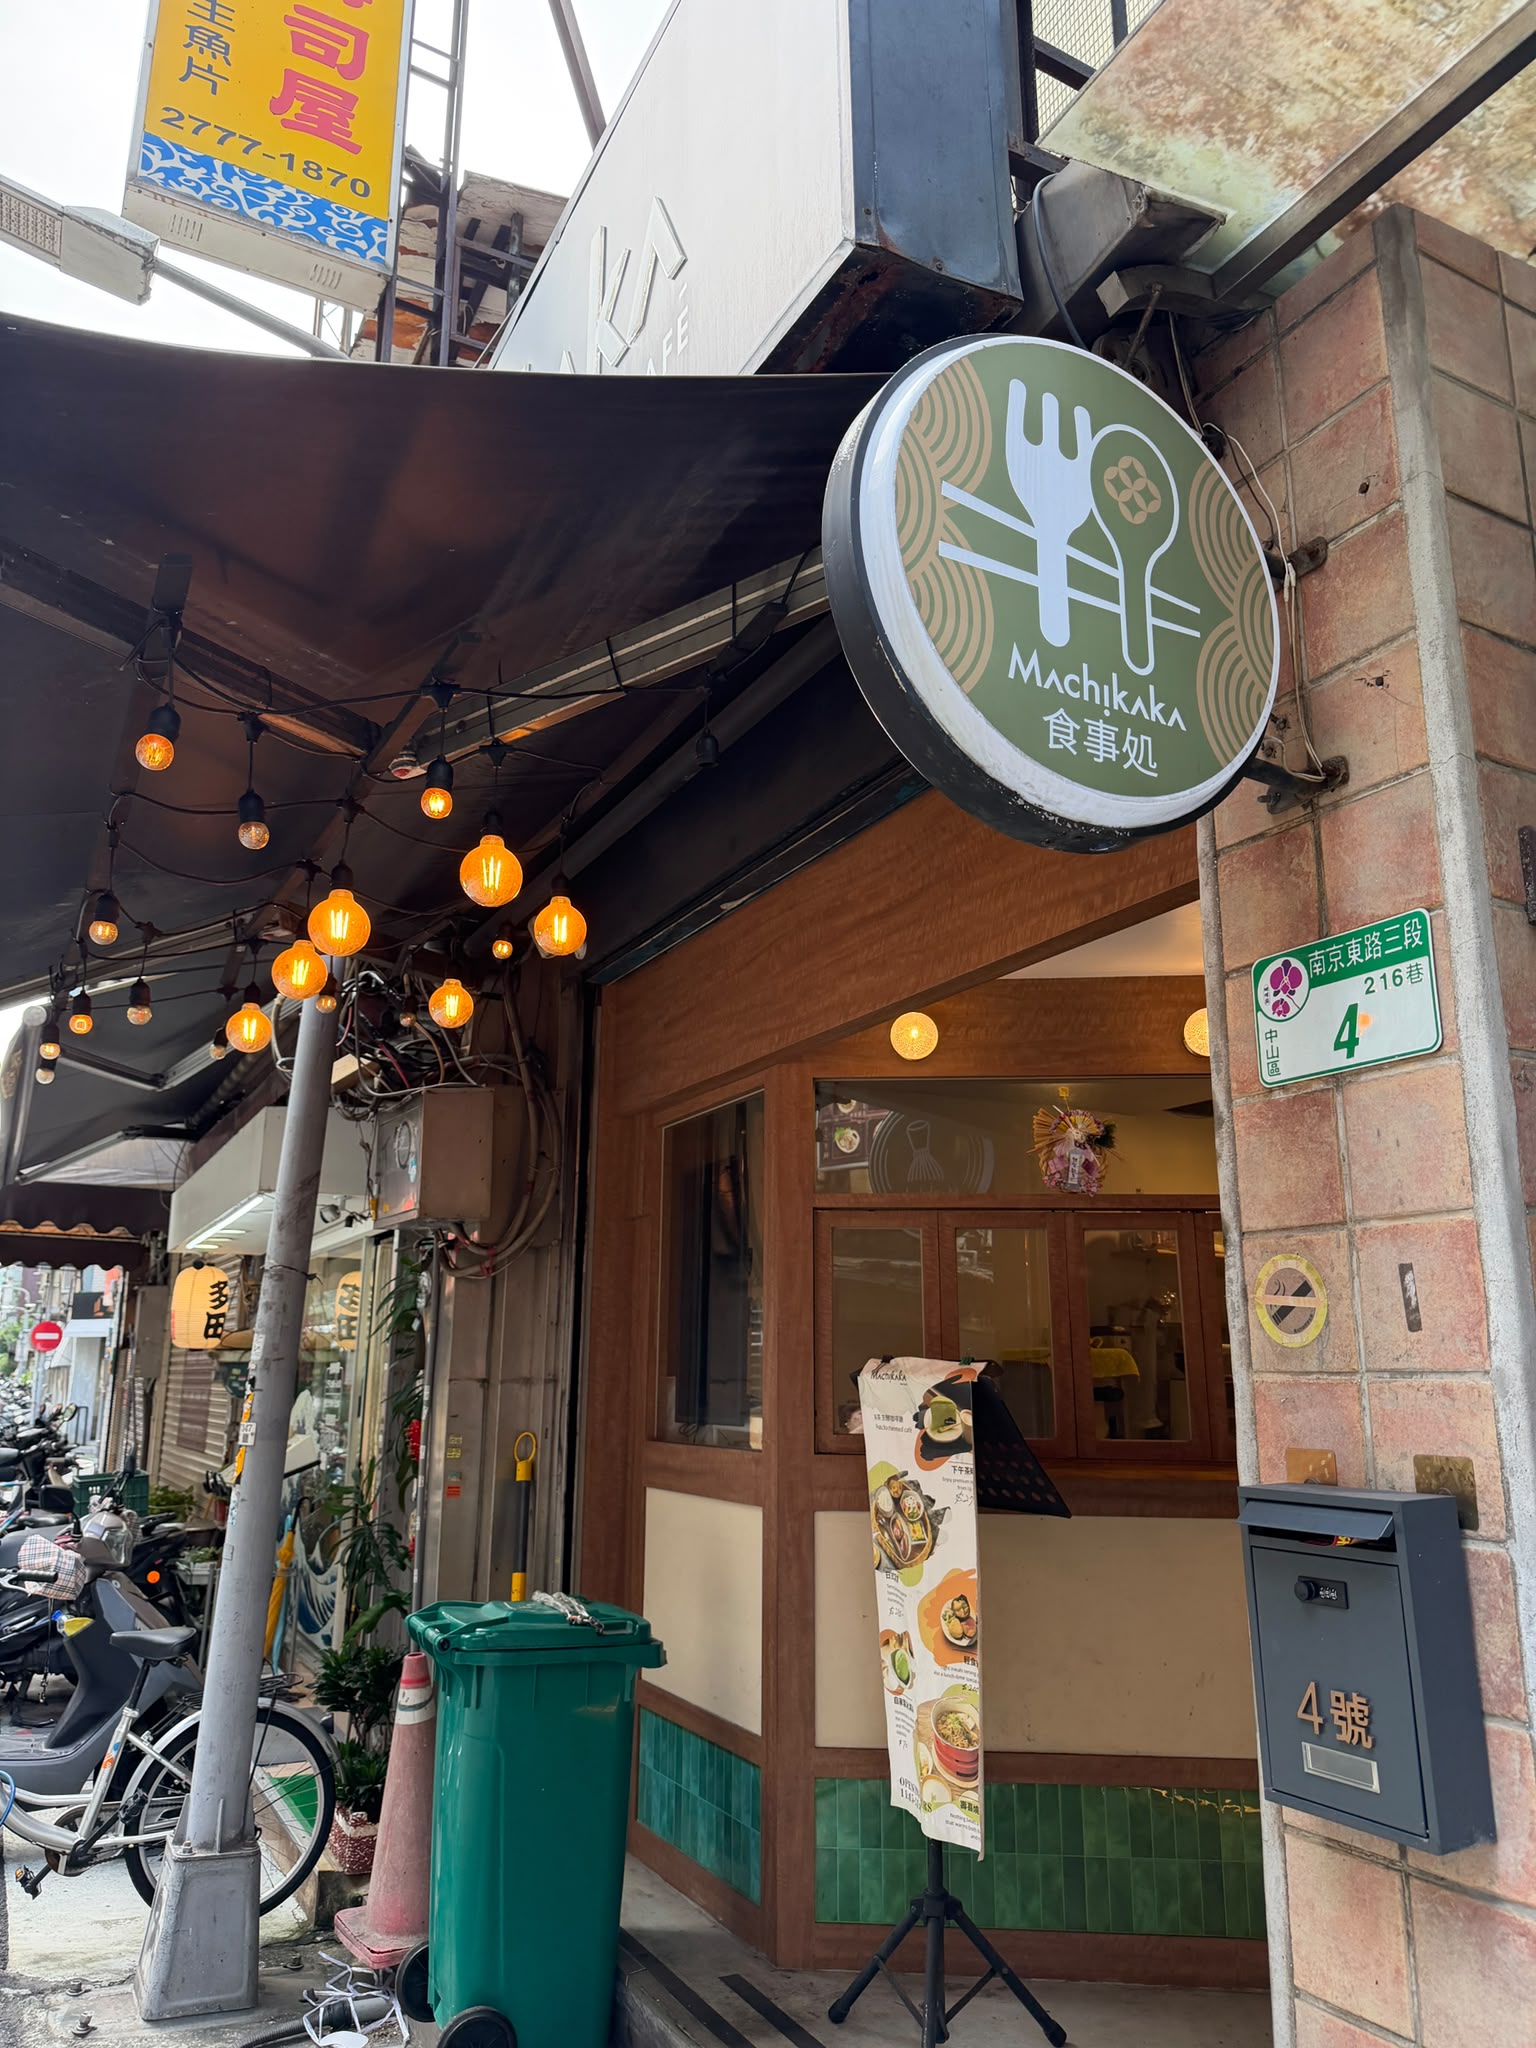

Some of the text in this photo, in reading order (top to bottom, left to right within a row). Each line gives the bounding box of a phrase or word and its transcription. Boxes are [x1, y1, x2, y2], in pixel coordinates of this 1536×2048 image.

[269, 0, 373, 155] 司屋
[159, 106, 371, 198] 2777-1870
[1042, 707, 1158, 778] 食事処
[1308, 917, 1423, 979] 南京東路三段
[1364, 961, 1425, 995] 216巷
[1264, 1028, 1281, 1077] 中山區
[1333, 1002, 1360, 1059] 4
[204, 1280, 229, 1340] 多田
[1296, 1681, 1373, 1750] 4號
